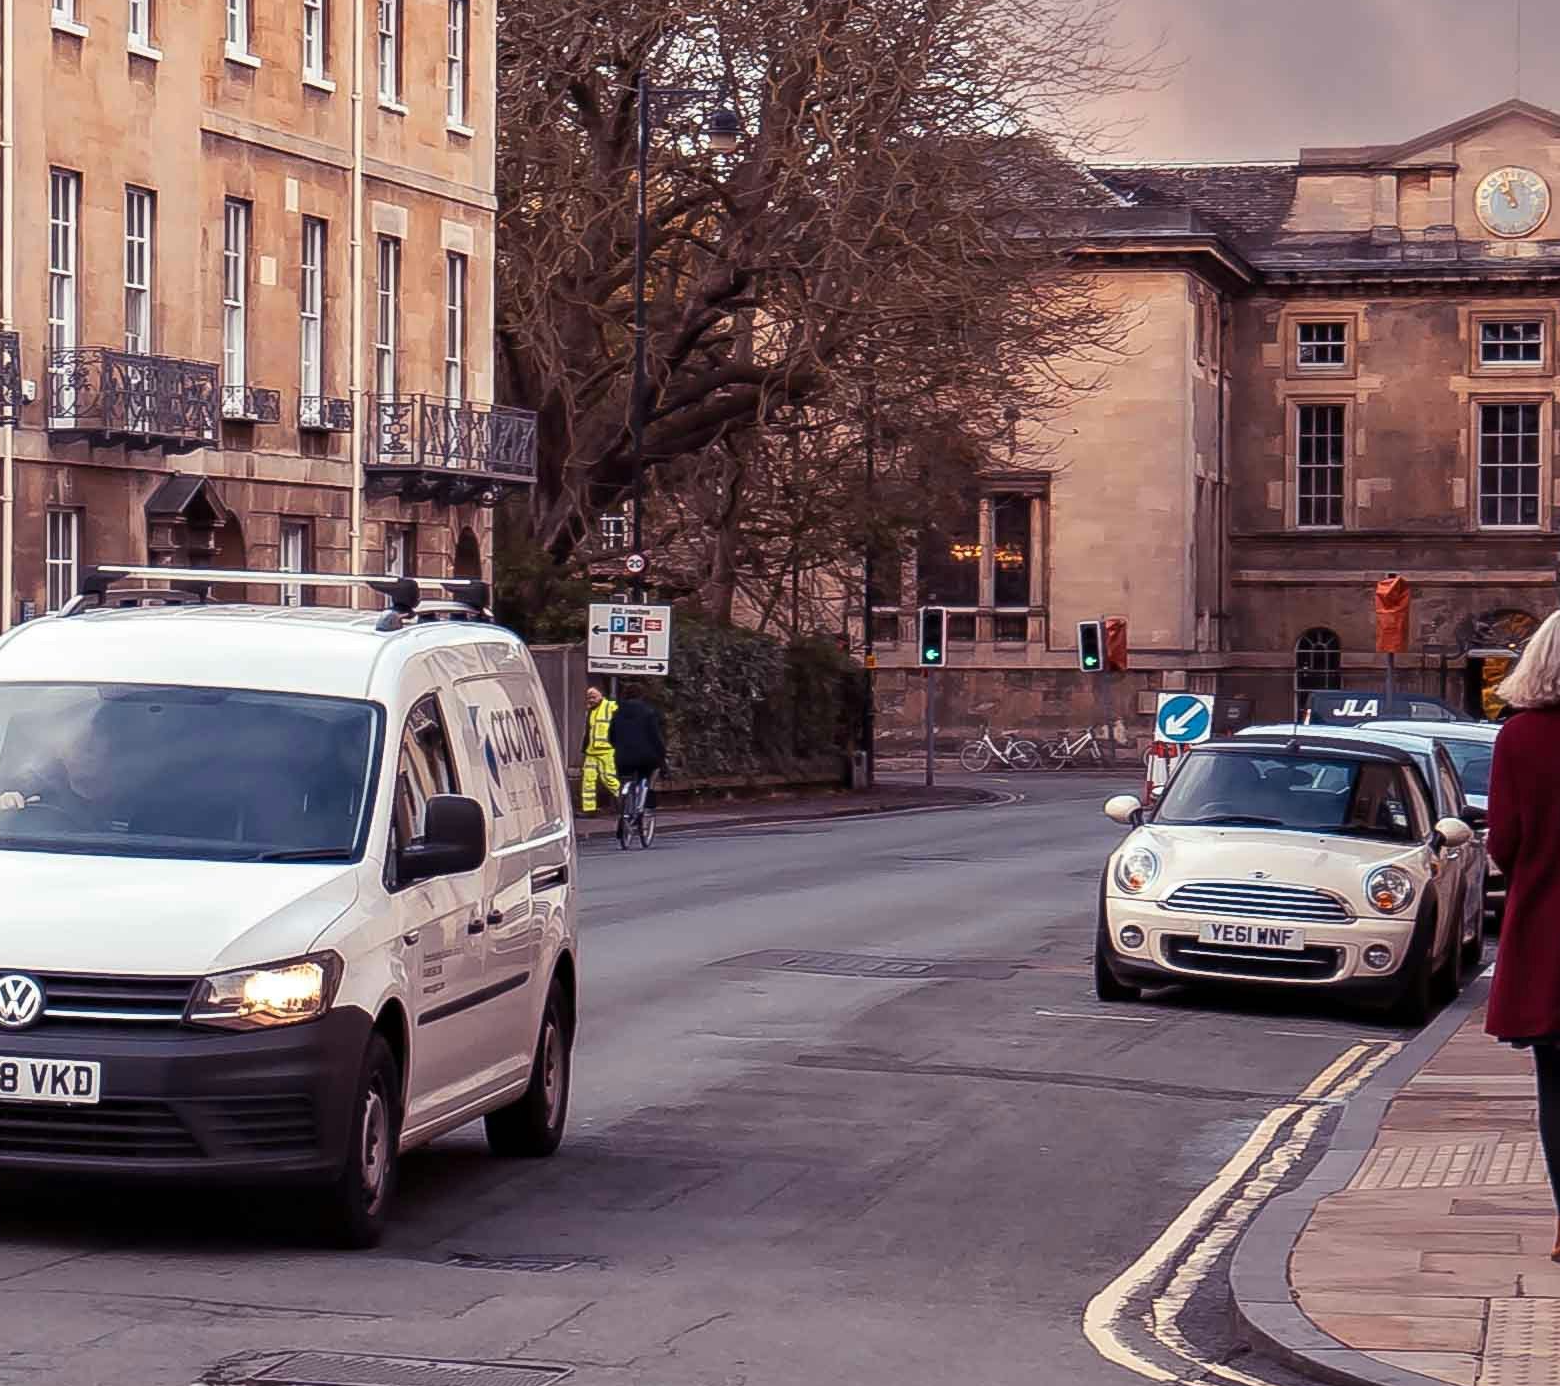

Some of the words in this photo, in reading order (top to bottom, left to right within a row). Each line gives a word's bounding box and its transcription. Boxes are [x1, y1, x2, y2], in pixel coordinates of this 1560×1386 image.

[1333, 699, 1378, 717] JLA
[1211, 923, 1252, 943] YE61
[30, 1064, 93, 1095] VKD
